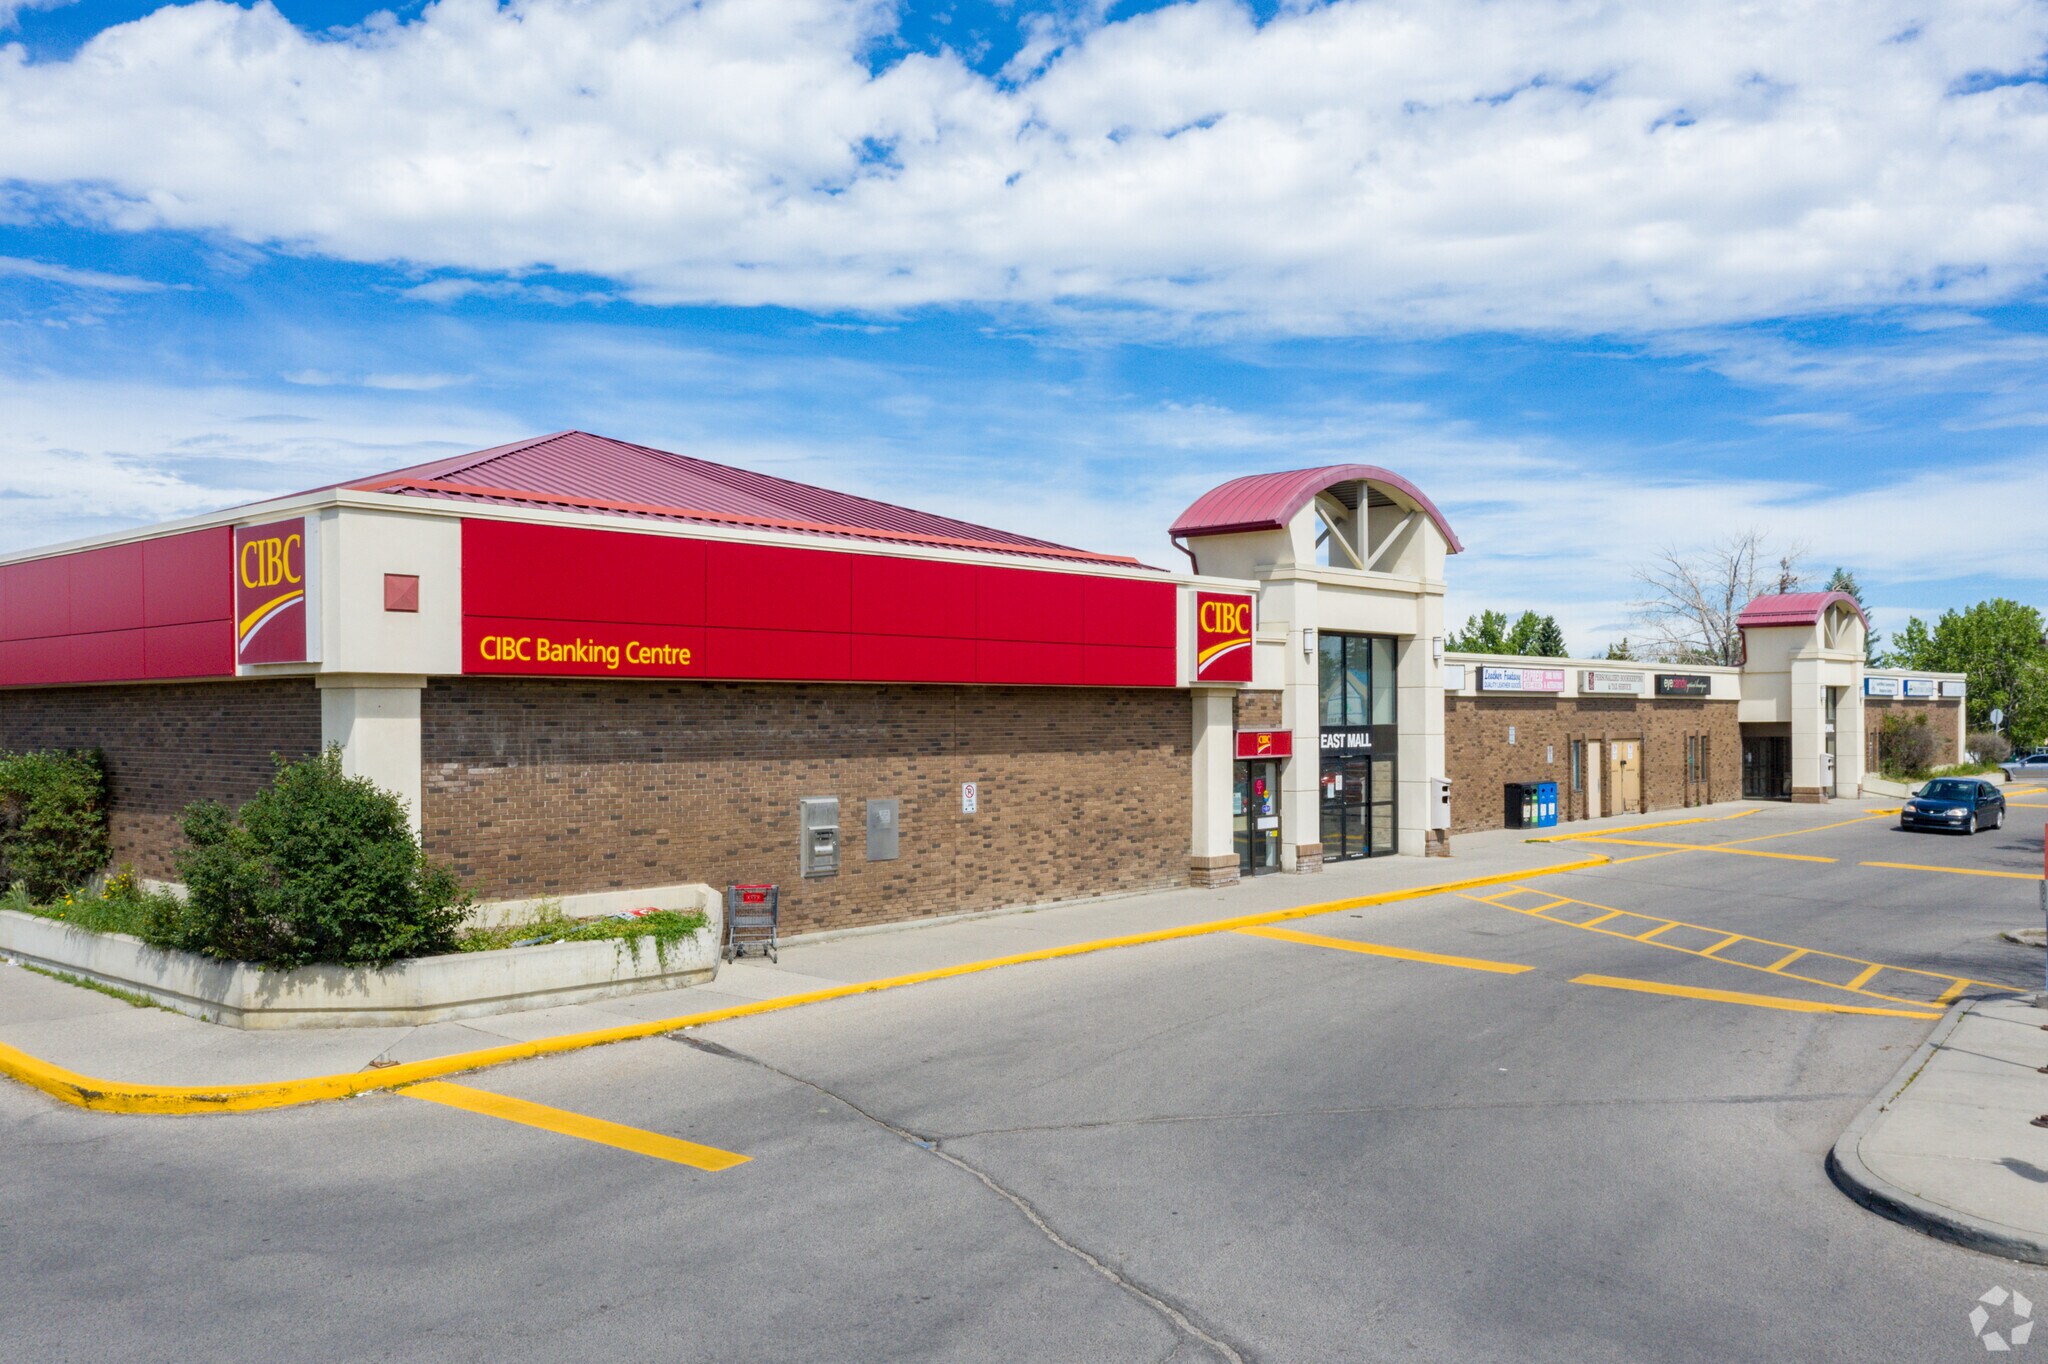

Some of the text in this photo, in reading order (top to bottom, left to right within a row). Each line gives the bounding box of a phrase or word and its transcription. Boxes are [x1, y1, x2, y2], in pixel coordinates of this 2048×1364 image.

[240, 533, 301, 589] CIBC
[1200, 600, 1250, 635] CIBC
[480, 635, 691, 670] CIBC Banking Centre
[1320, 733, 1372, 749] EAST MALL
